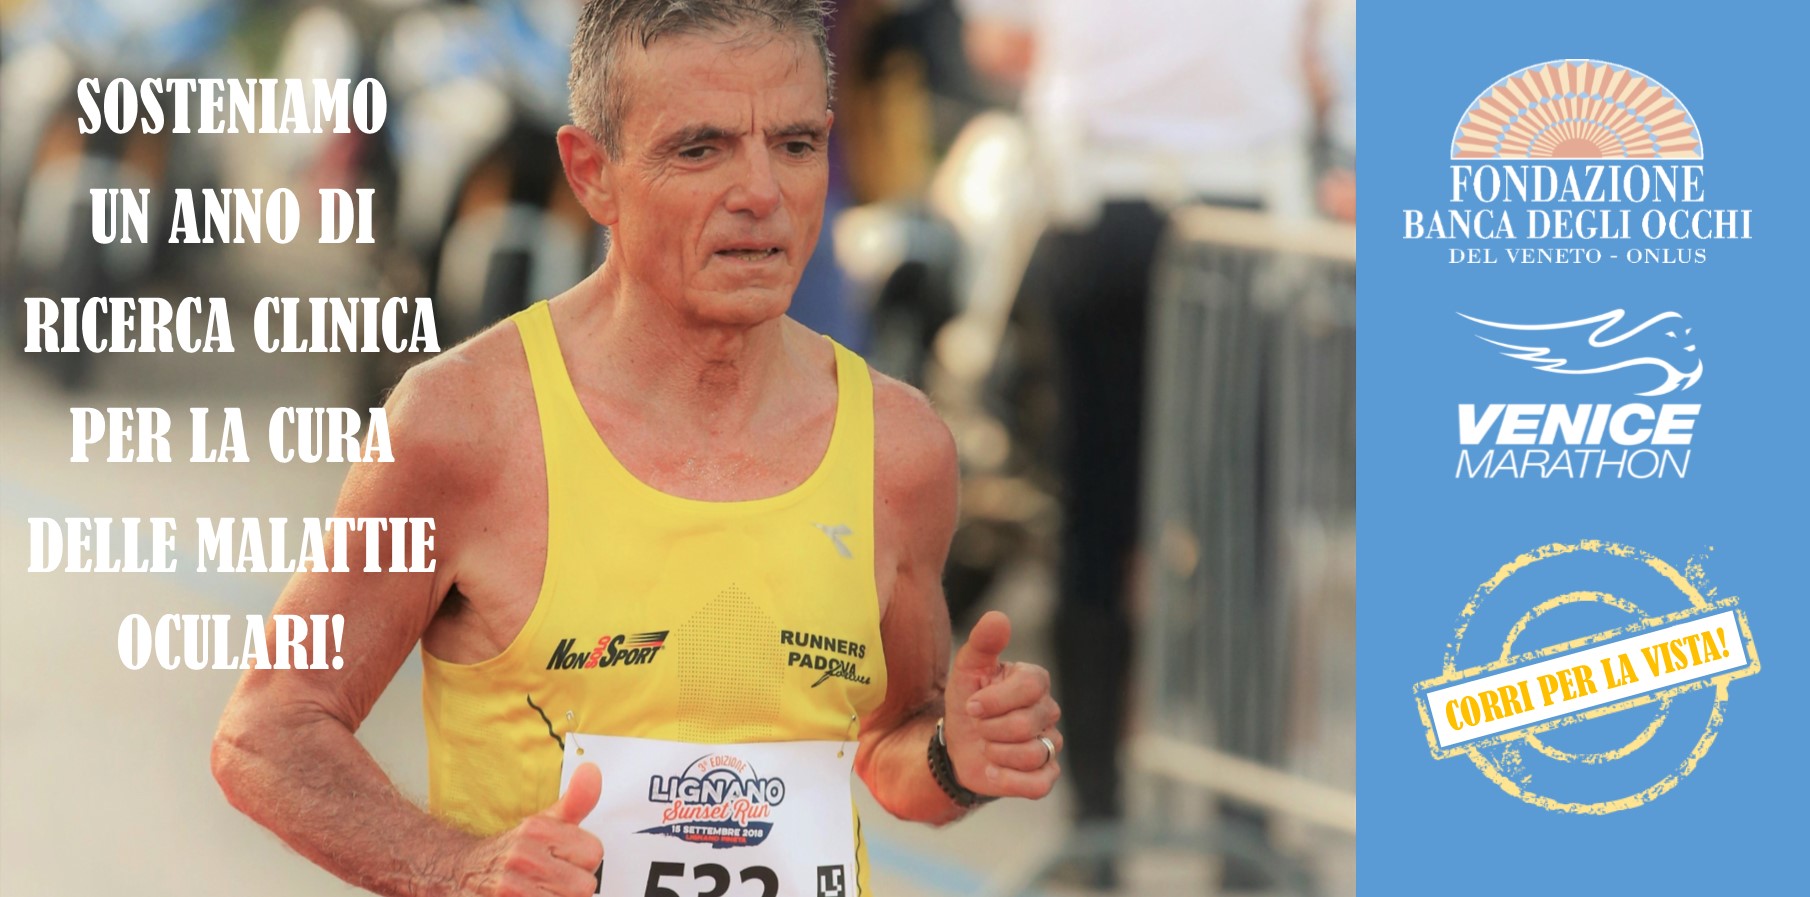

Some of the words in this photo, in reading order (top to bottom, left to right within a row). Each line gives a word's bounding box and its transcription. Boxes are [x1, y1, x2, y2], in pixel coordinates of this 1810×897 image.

[780, 629, 866, 659] RUNNERS
[788, 651, 857, 676] PADOVA
[709, 755, 747, 773] EDIZIONE
[649, 775, 785, 806] LIGNANO
[663, 799, 730, 824] Sunset
[733, 799, 769, 825] Run
[683, 826, 741, 836] SETTEMBRE
[742, 829, 764, 838] 2018
